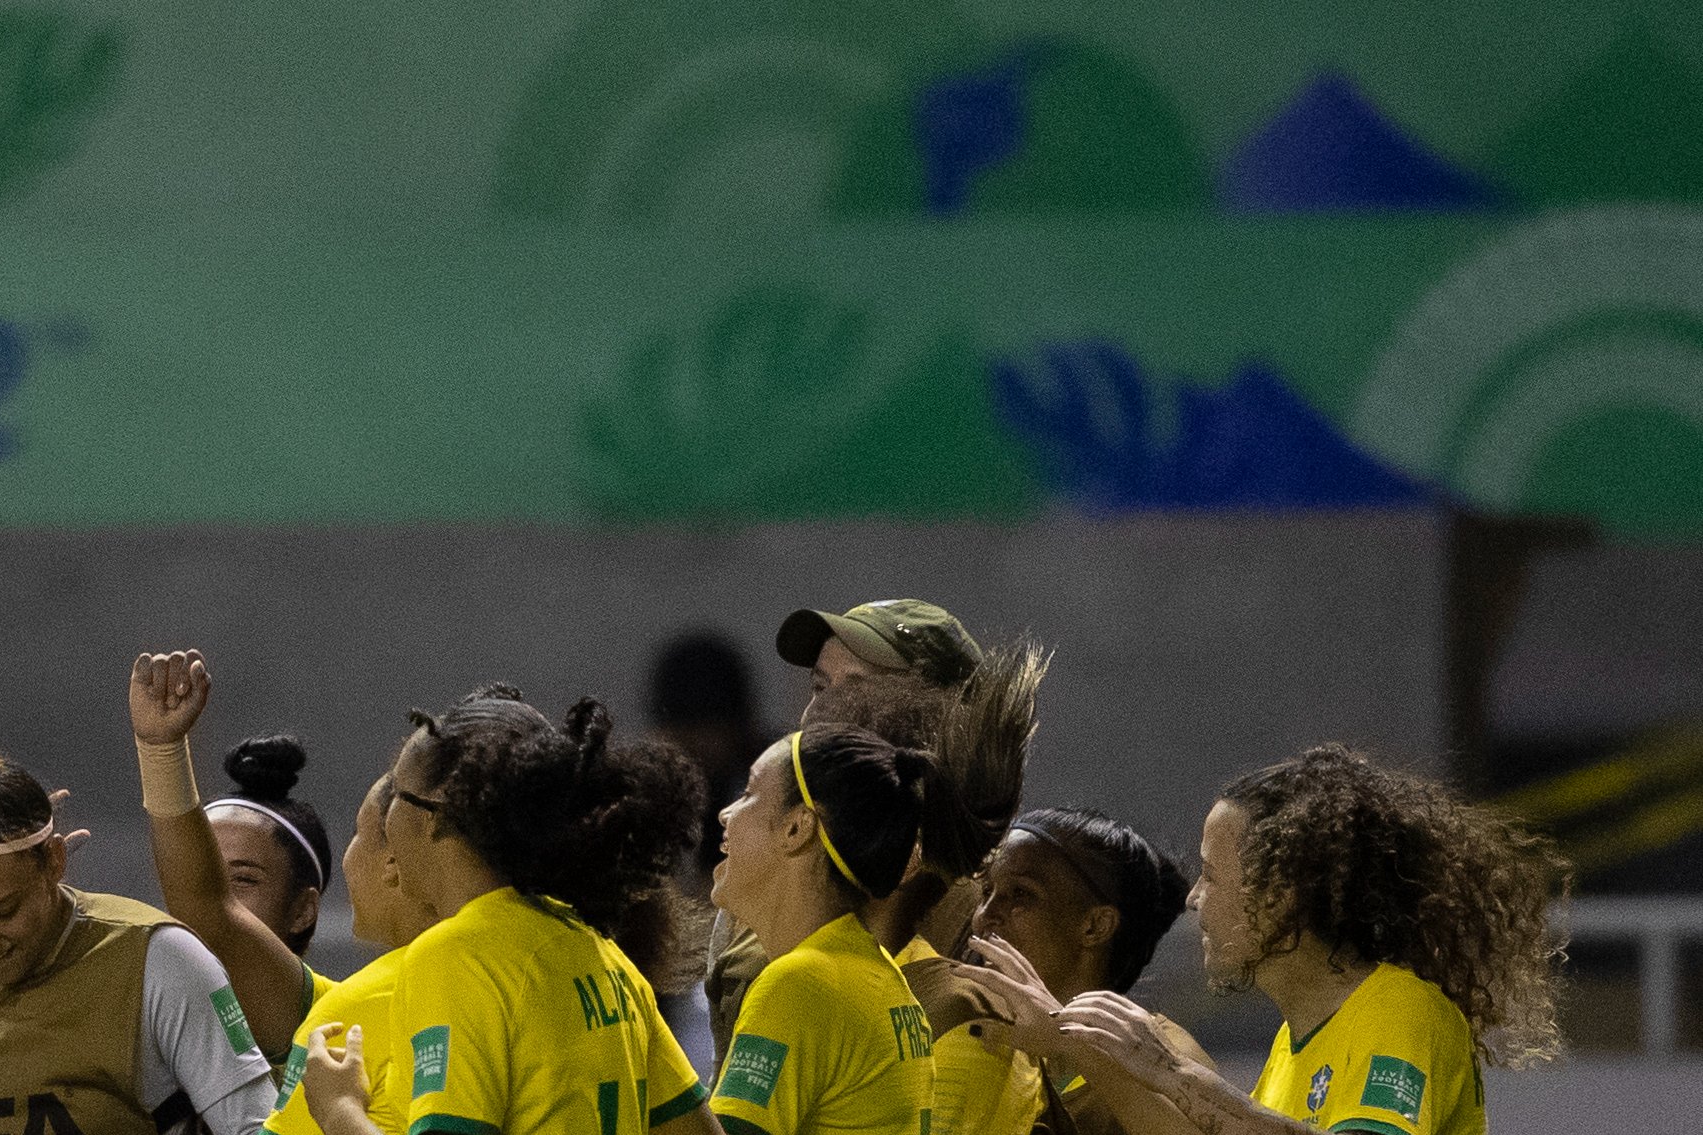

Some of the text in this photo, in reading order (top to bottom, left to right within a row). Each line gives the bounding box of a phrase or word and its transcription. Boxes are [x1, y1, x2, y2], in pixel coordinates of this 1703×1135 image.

[889, 1005, 931, 1061] PRIS
[730, 1060, 775, 1075] FOOTBALL
[732, 1051, 778, 1069] LIVING
[747, 1075, 770, 1090] FIFA
[1371, 1076, 1419, 1097] FOOTBALL
[1372, 1070, 1420, 1092] LIVING
[1396, 1090, 1417, 1108] FIFA
